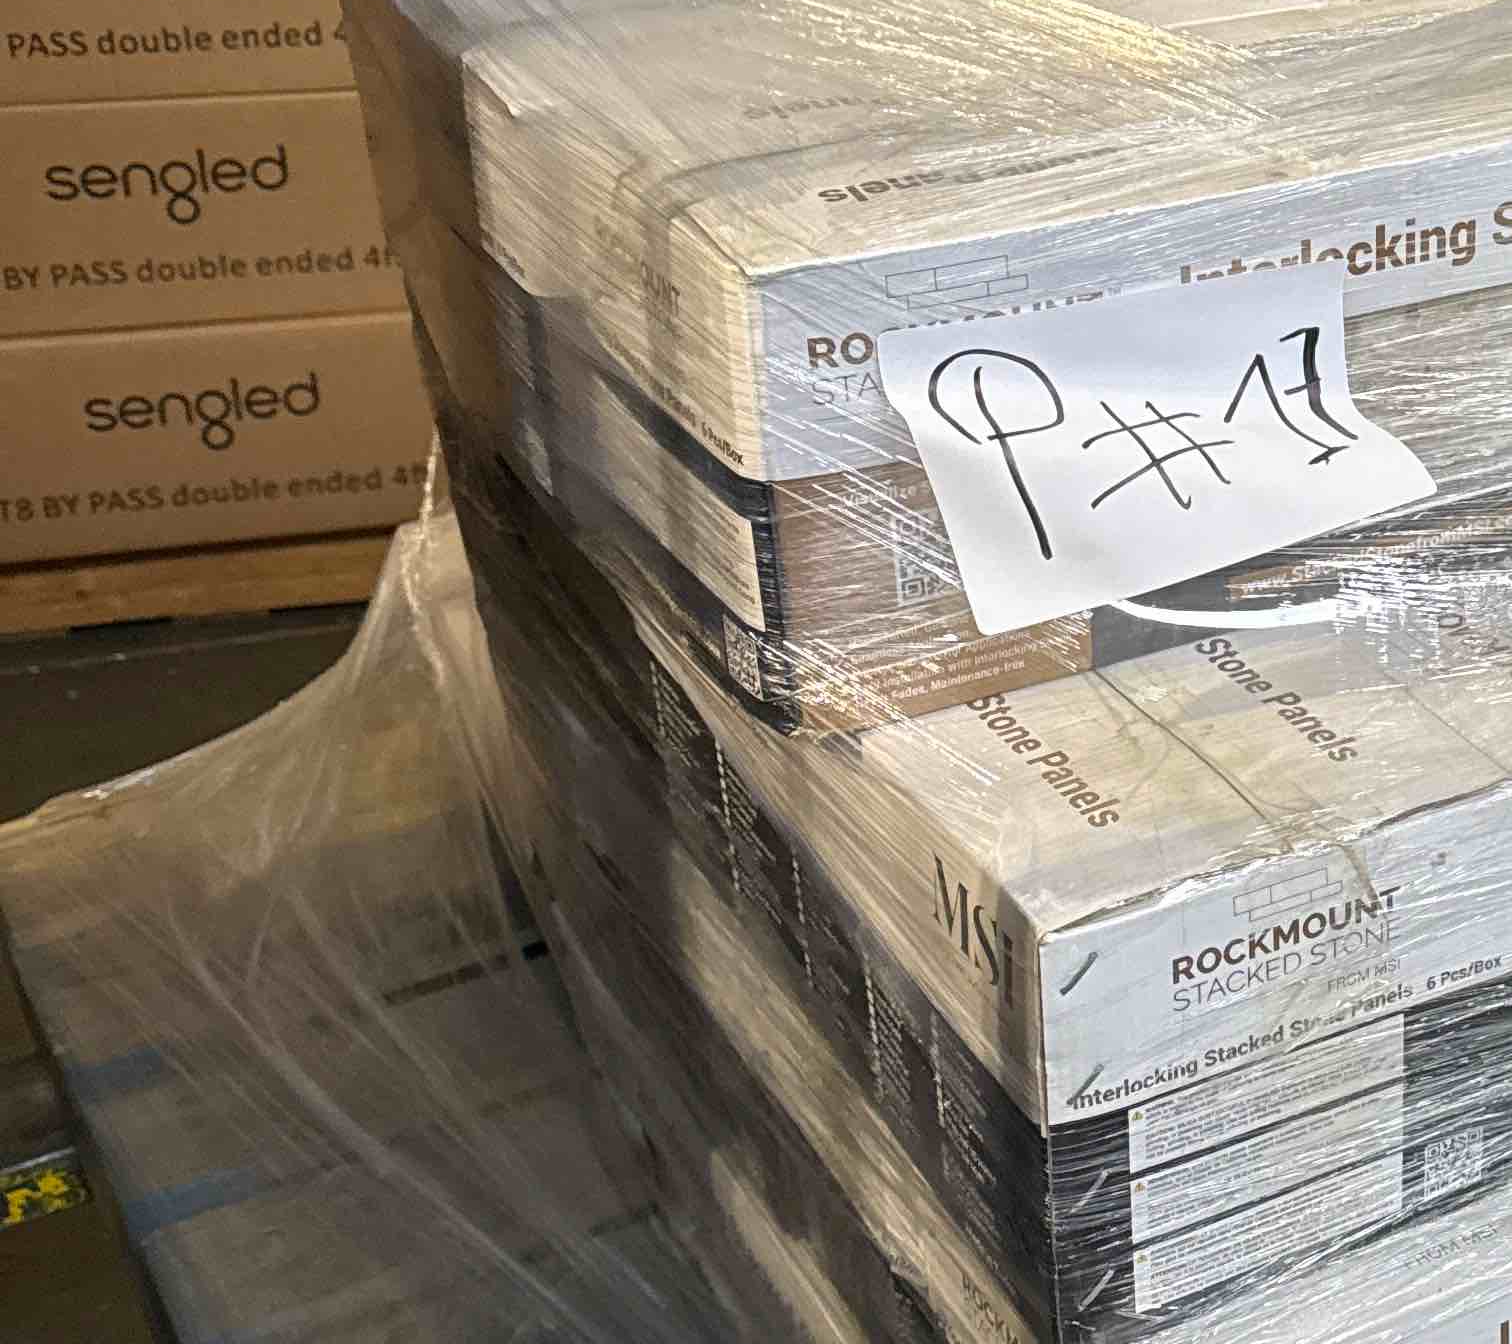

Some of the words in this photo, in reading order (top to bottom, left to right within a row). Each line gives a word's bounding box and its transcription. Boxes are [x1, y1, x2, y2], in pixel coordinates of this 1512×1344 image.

[7, 31, 89, 57] PASS
[97, 26, 211, 55] double
[221, 21, 323, 51] ended
[45, 143, 289, 225] sengled
[3, 265, 39, 291] BY
[51, 260, 128, 288] PASS
[137, 254, 246, 283] double
[256, 248, 354, 275] ended
[84, 371, 320, 451] sengled
[43, 494, 79, 519] BY
[89, 487, 164, 515] PASS
[172, 477, 280, 508] double
[289, 467, 383, 498] ended
[1195, 636, 1274, 695] Stone
[1265, 690, 1361, 764] Panels
[966, 692, 1042, 756] Stone
[1026, 749, 1121, 830] Panels
[933, 853, 1015, 1011] MSI
[1171, 885, 1403, 986] ROCKMOUNT
[1171, 955, 1303, 1013] STACKED
[1308, 918, 1401, 968] STONE
[1203, 1023, 1286, 1069] Stacked
[1425, 975, 1437, 992] 6
[1438, 956, 1503, 989] Pcs/Box
